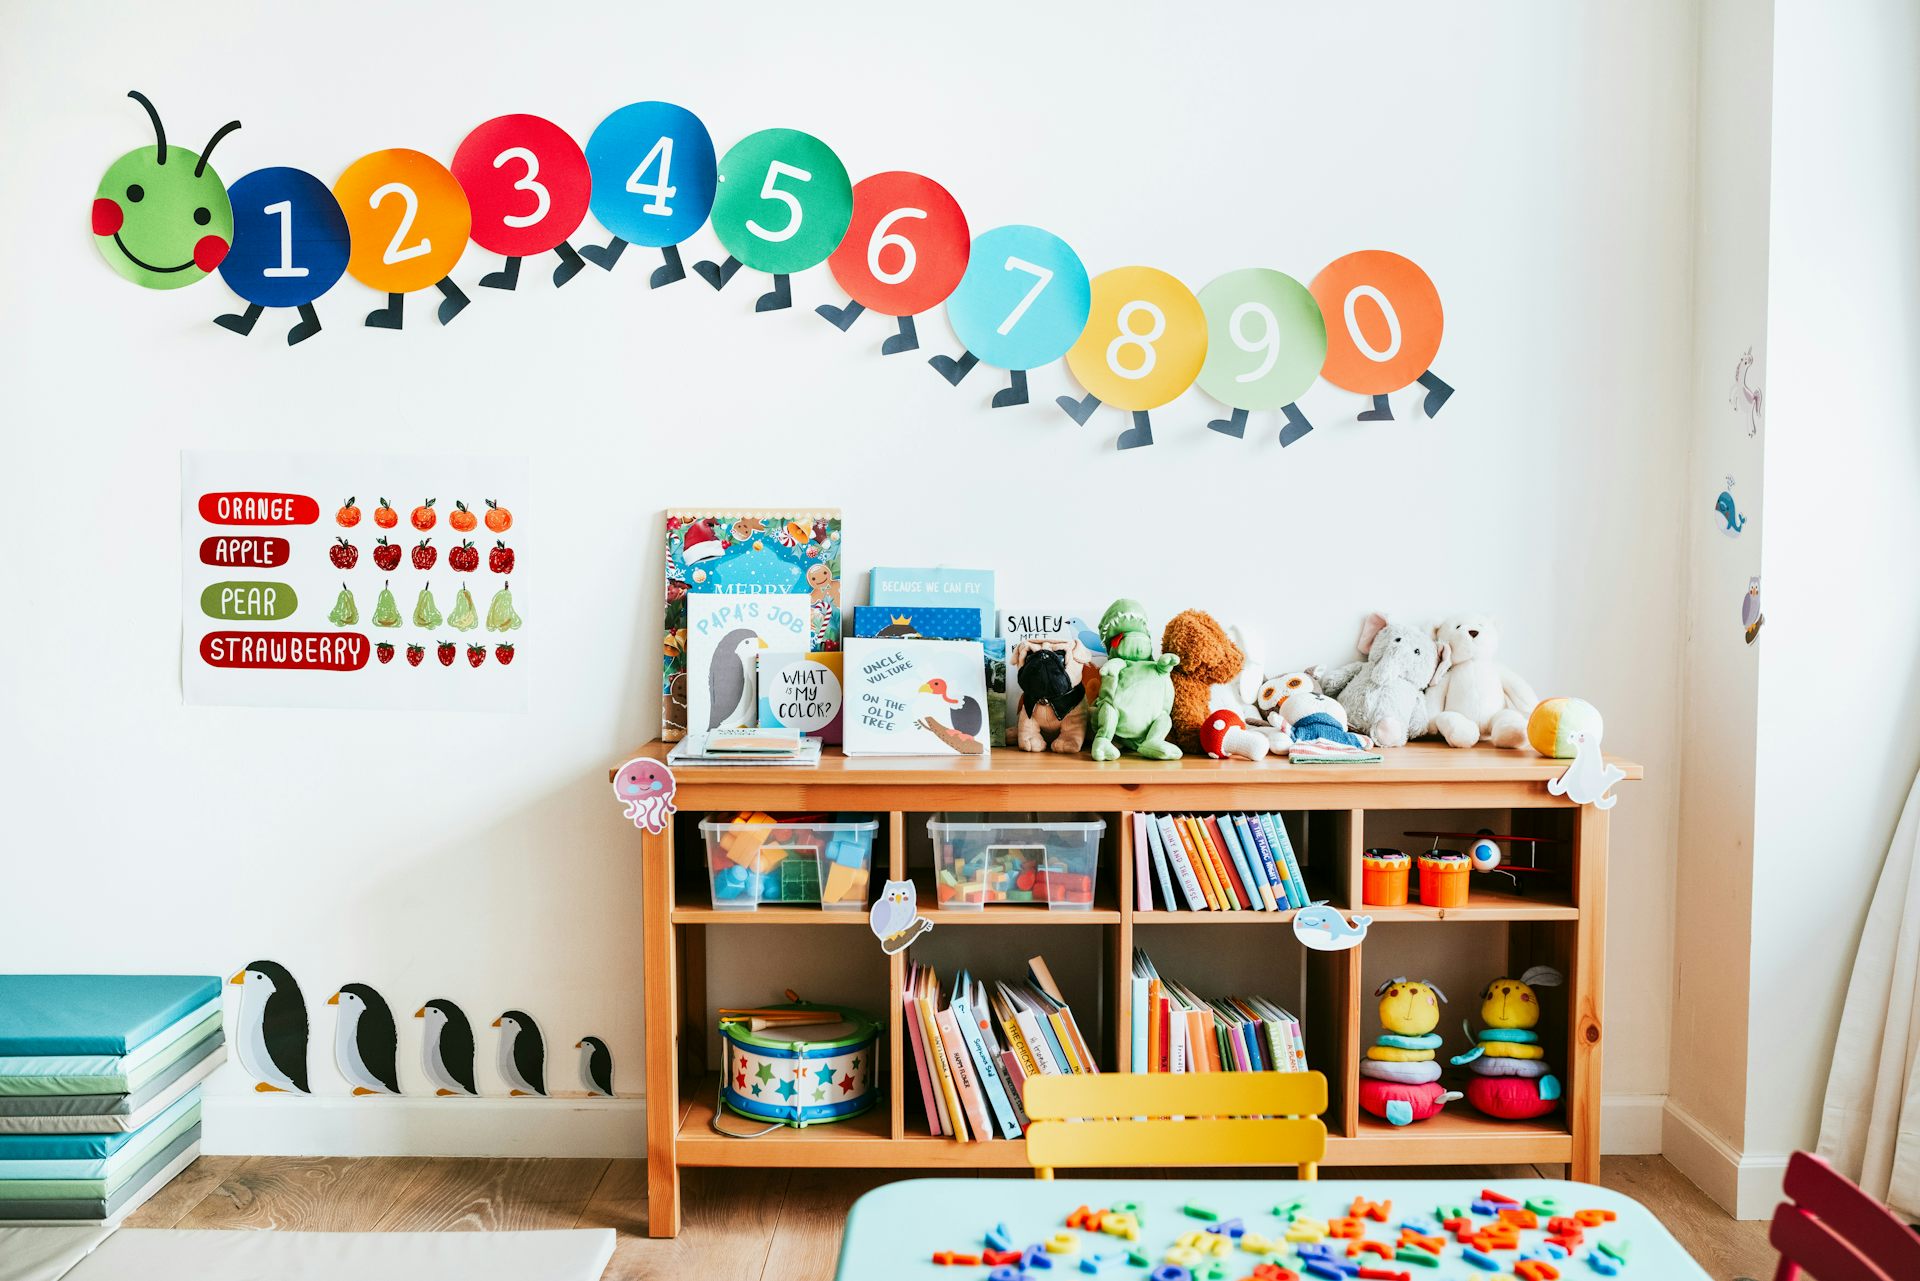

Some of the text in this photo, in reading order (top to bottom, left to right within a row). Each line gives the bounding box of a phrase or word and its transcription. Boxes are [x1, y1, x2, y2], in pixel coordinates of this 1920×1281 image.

[263, 136, 1402, 383] 1 2 3 4 5 6 7 8 9 0
[217, 497, 295, 522] ORANGE
[215, 539, 274, 565] APPLE
[882, 581, 981, 593] BECAUSE WE CAN FLY
[220, 587, 277, 616] PEAR
[697, 602, 805, 635] PAPA'S JOB
[1008, 615, 1063, 633] SALLEY
[210, 637, 361, 666] STRAWBERRY
[863, 651, 904, 675] UNCLE
[782, 669, 828, 685] WHAT
[866, 660, 913, 685] VULTURE
[795, 686, 818, 702] MY
[862, 693, 906, 712] ON THE
[779, 702, 832, 719] COLOR?
[862, 714, 895, 731] TREE
[868, 706, 894, 719] OLD
[1172, 848, 1183, 863] AND
[1179, 864, 1189, 876] THE
[1253, 826, 1277, 881] THE MAGIC NIGHT
[1008, 1024, 1020, 1041] THE
[1015, 1040, 1036, 1076] CHICKEN
[954, 1052, 969, 1088] HAPPY FLOWER
